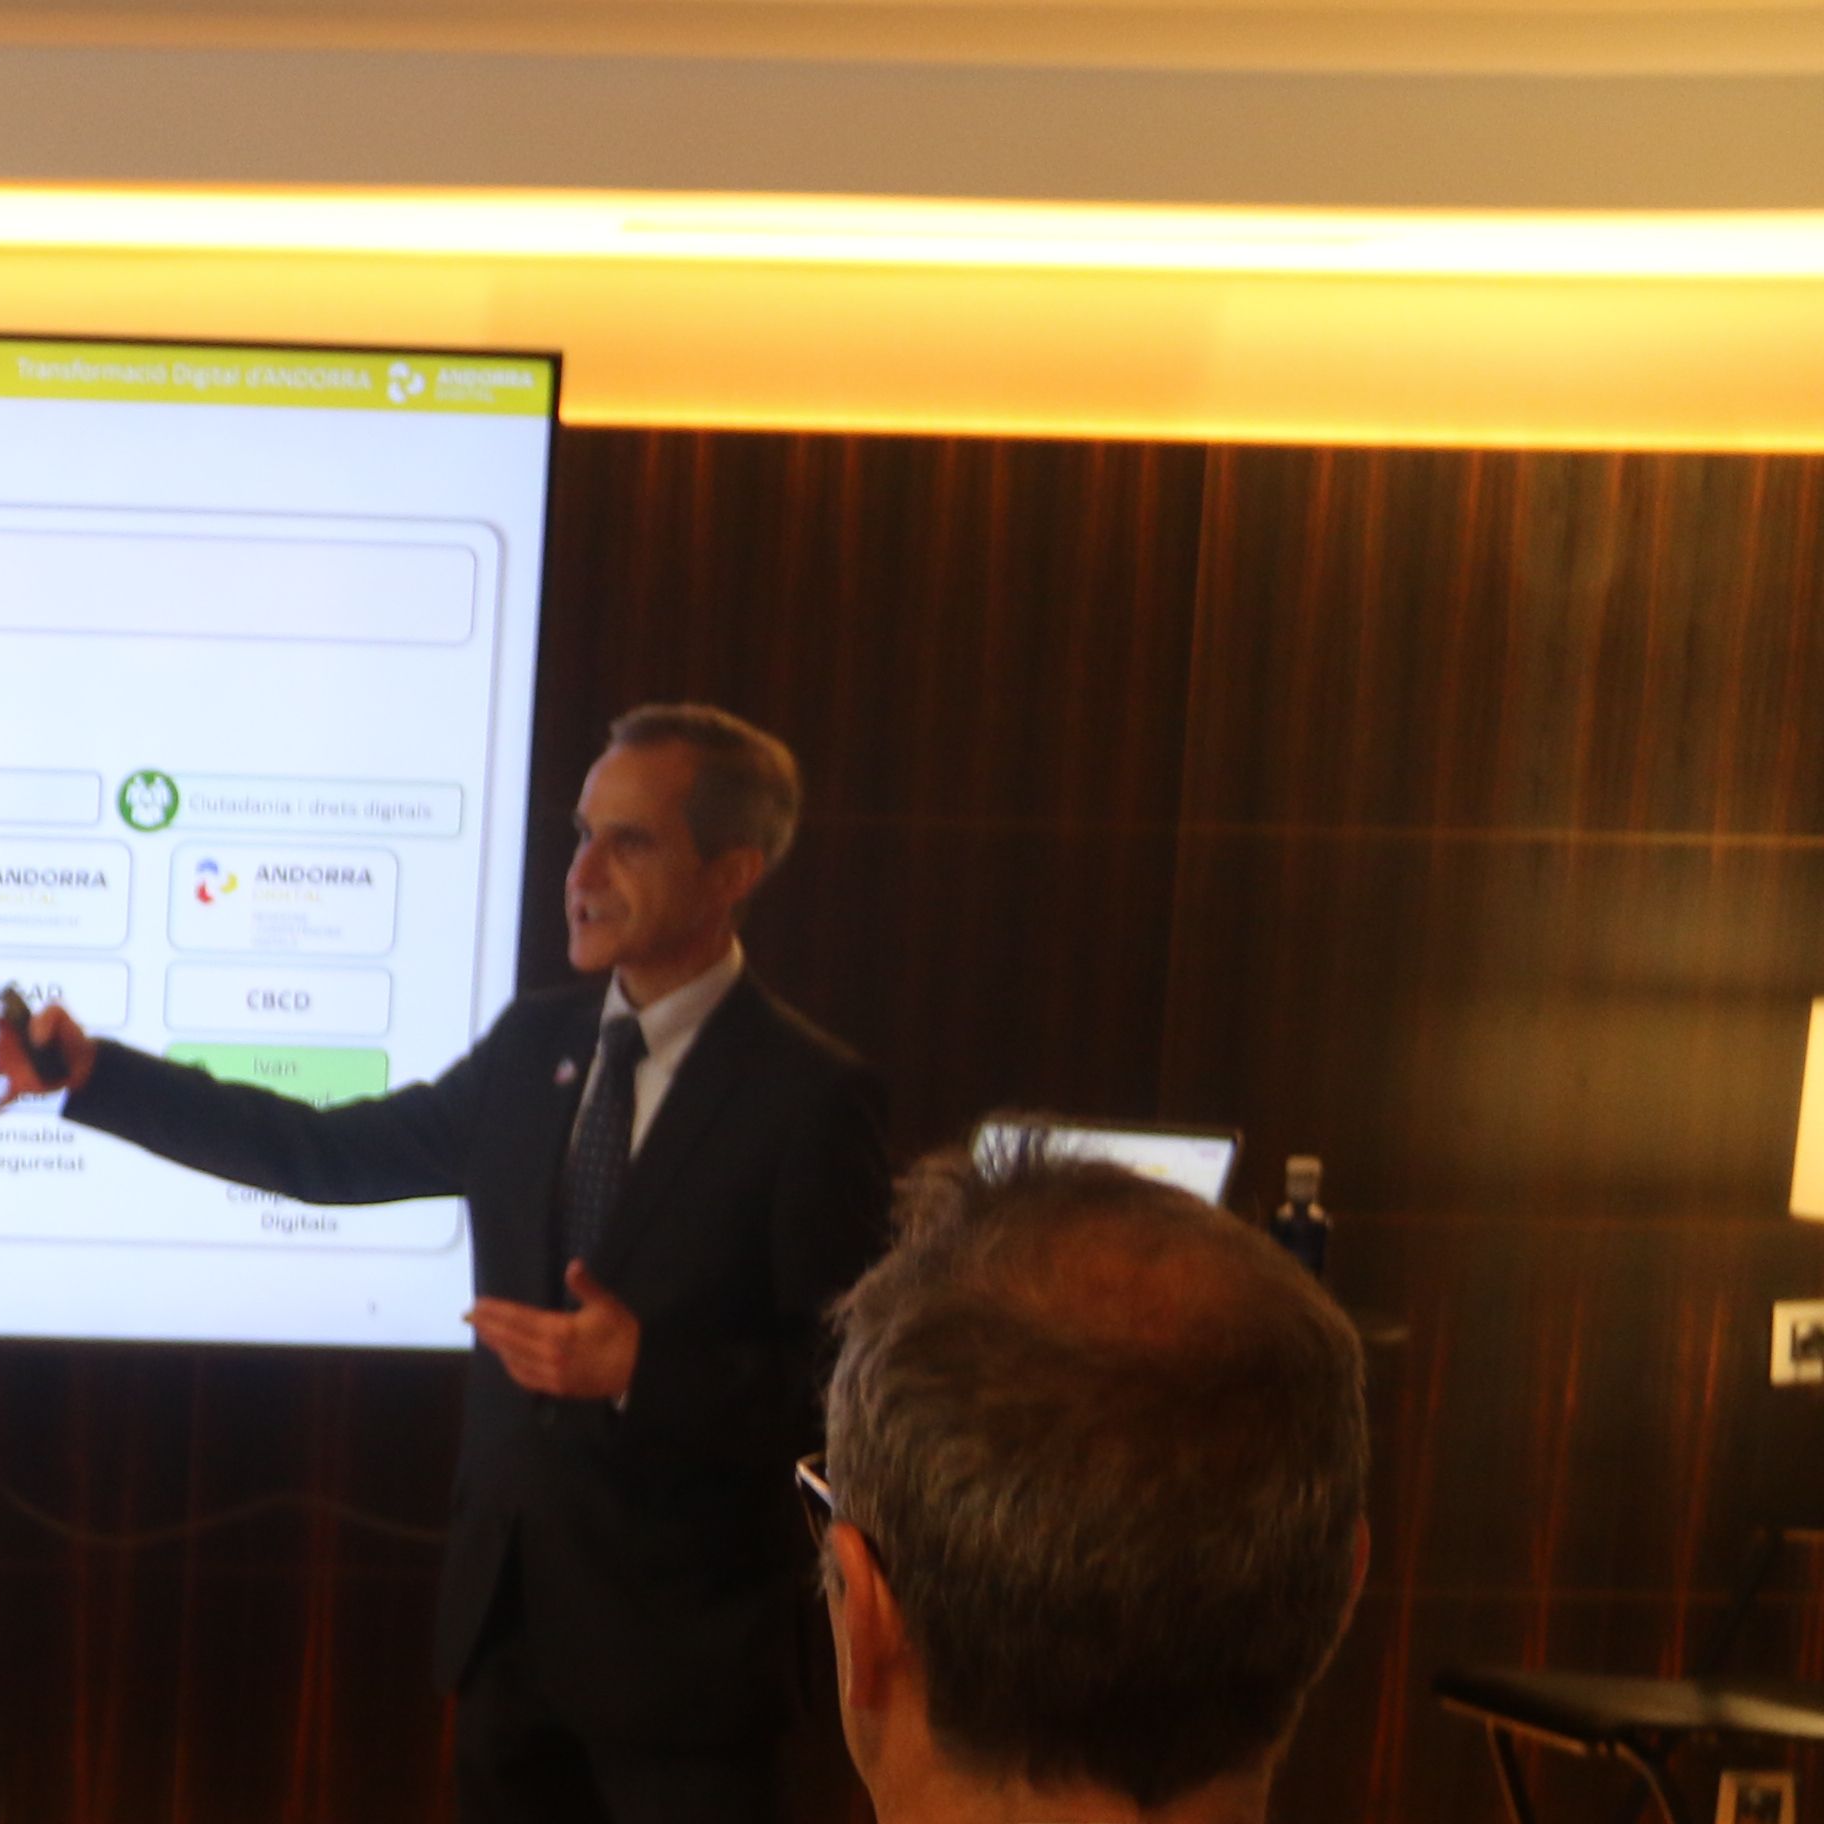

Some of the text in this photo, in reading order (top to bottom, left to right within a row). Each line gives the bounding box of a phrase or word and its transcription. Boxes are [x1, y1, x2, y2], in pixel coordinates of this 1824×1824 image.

[173, 361, 235, 391] Digital
[254, 864, 375, 888] ANDORRA
[245, 988, 312, 1012] CBCD
[259, 1212, 340, 1237] Digitals
